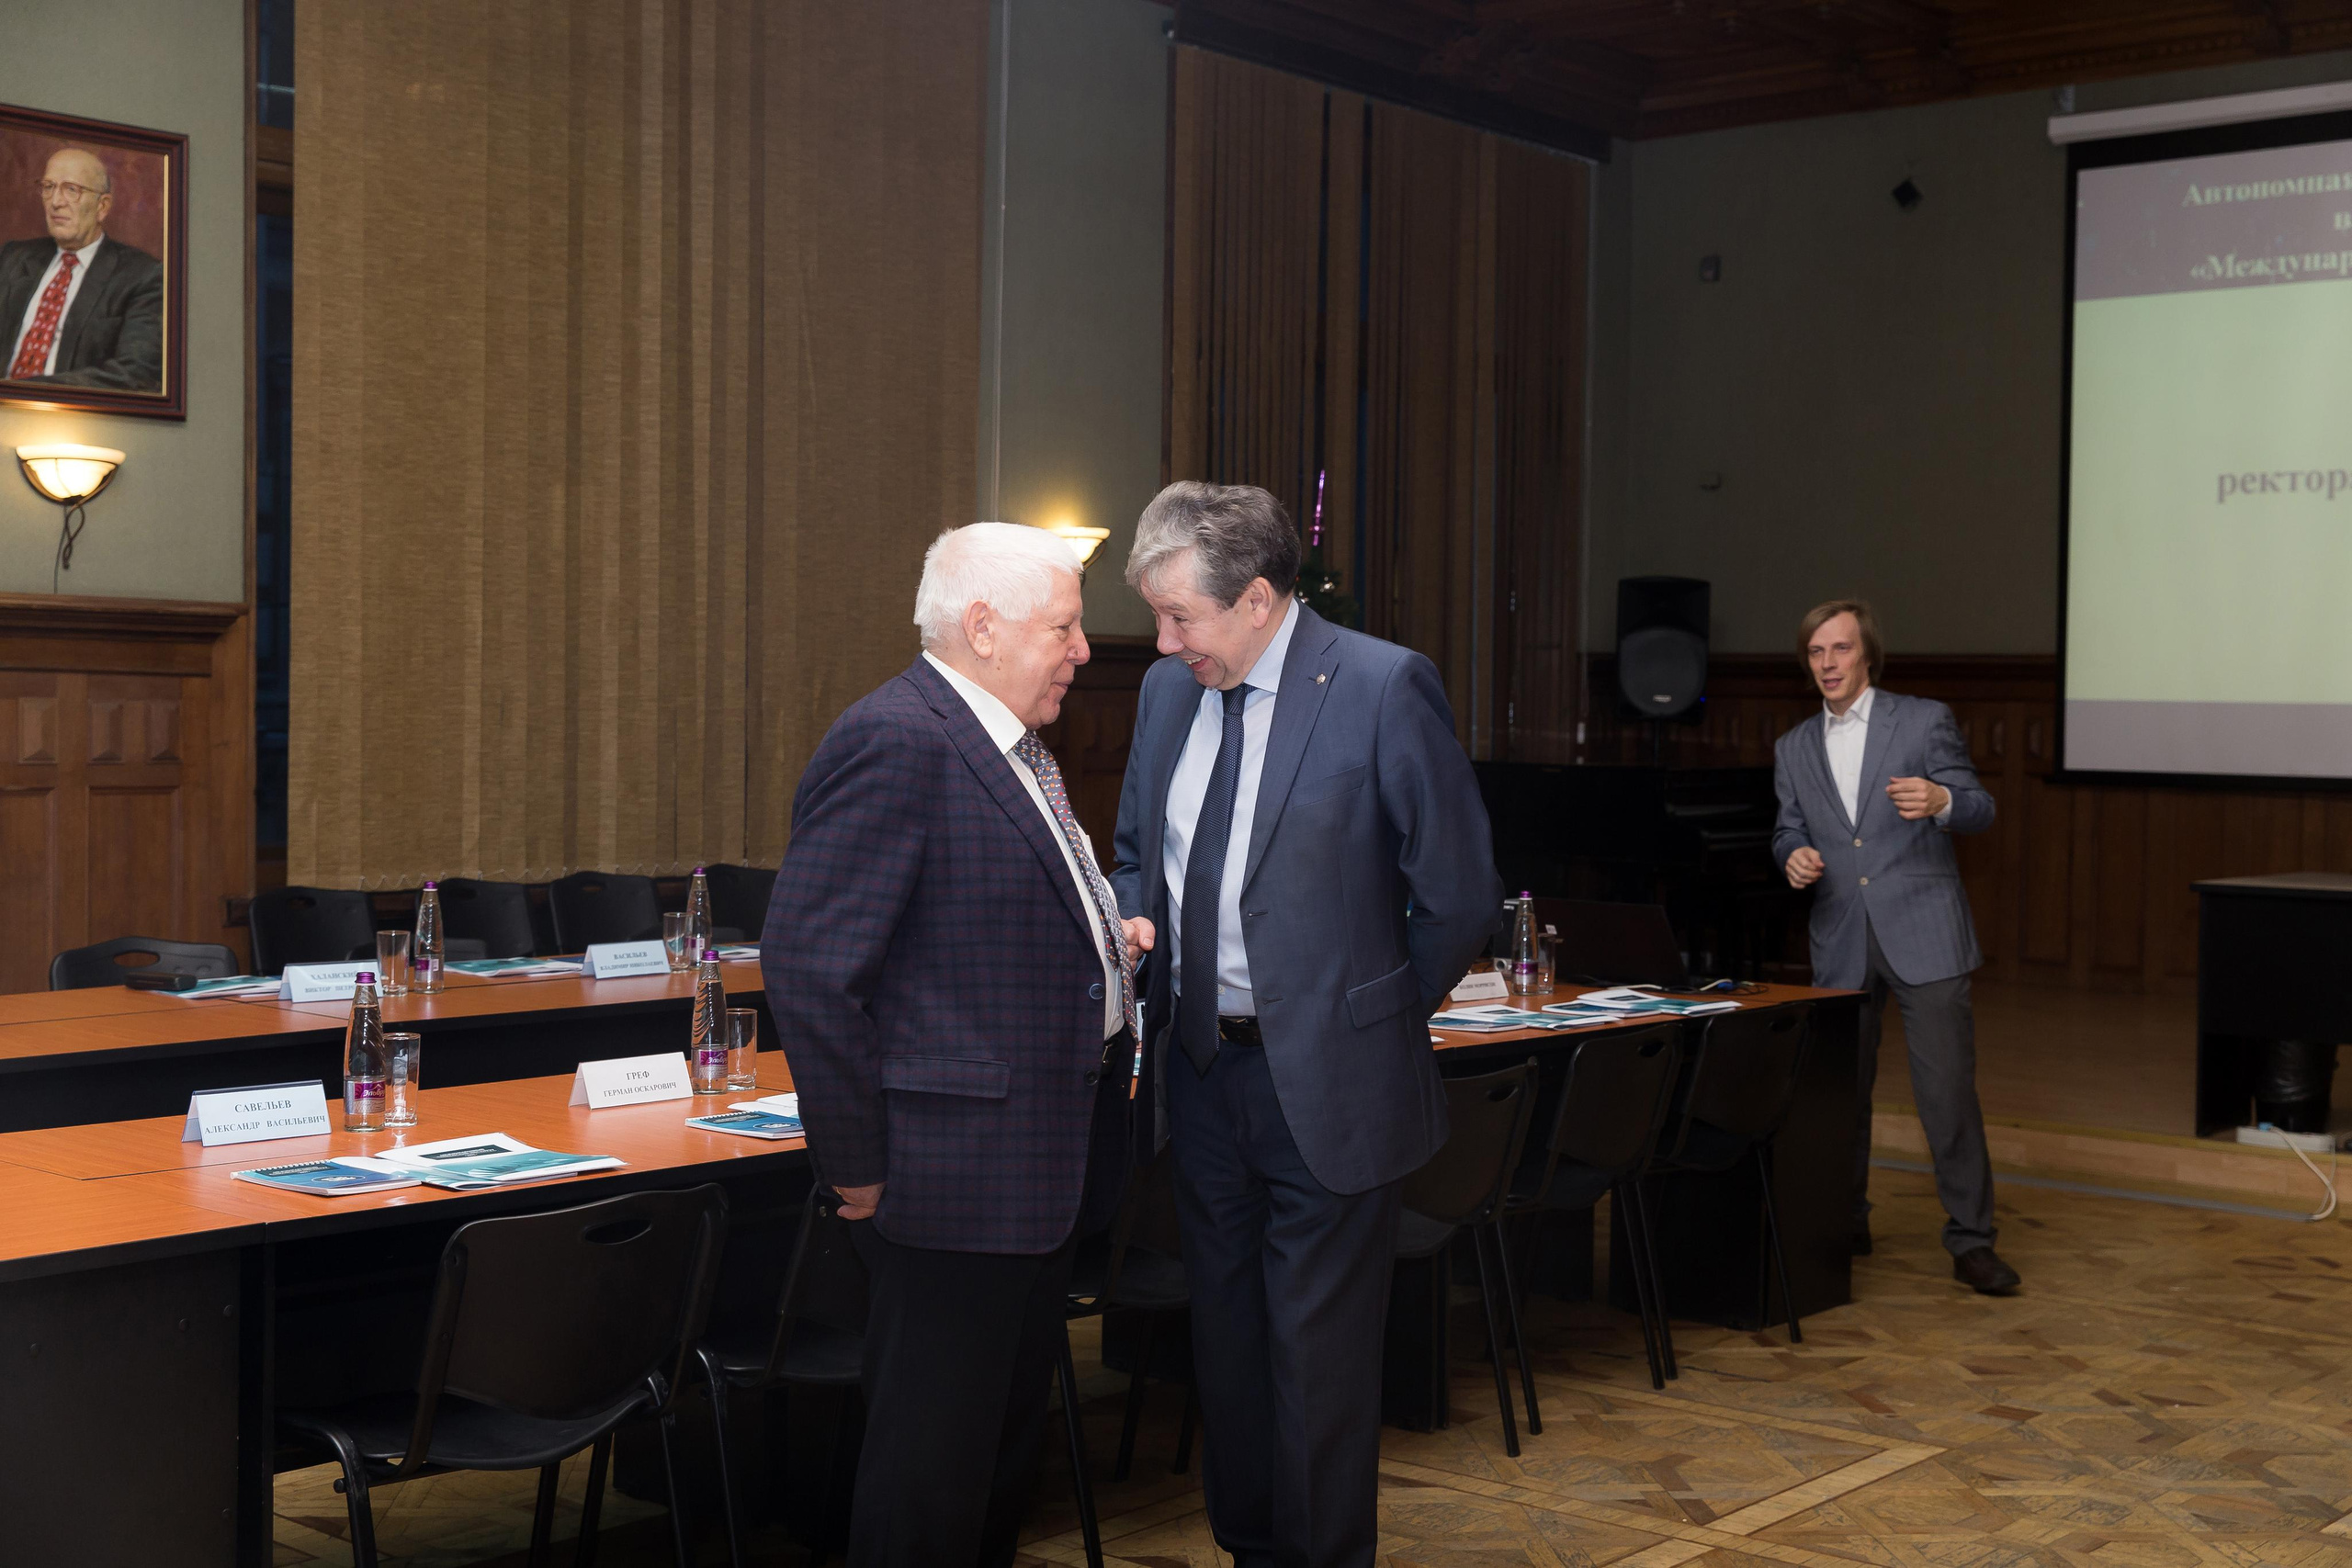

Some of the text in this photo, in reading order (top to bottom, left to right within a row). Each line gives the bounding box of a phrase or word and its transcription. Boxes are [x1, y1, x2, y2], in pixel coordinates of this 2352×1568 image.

[2217, 468, 2352, 504] ректор
[626, 1070, 650, 1080] ГРЕФ
[604, 1082, 677, 1097] ГЕРМАН ОСКАРОВИЧ
[234, 1100, 291, 1113] САВЕЛЬЕВ
[204, 1115, 326, 1134] АЛЕКСАНДР ВАСИЛЬЕВИЧ
